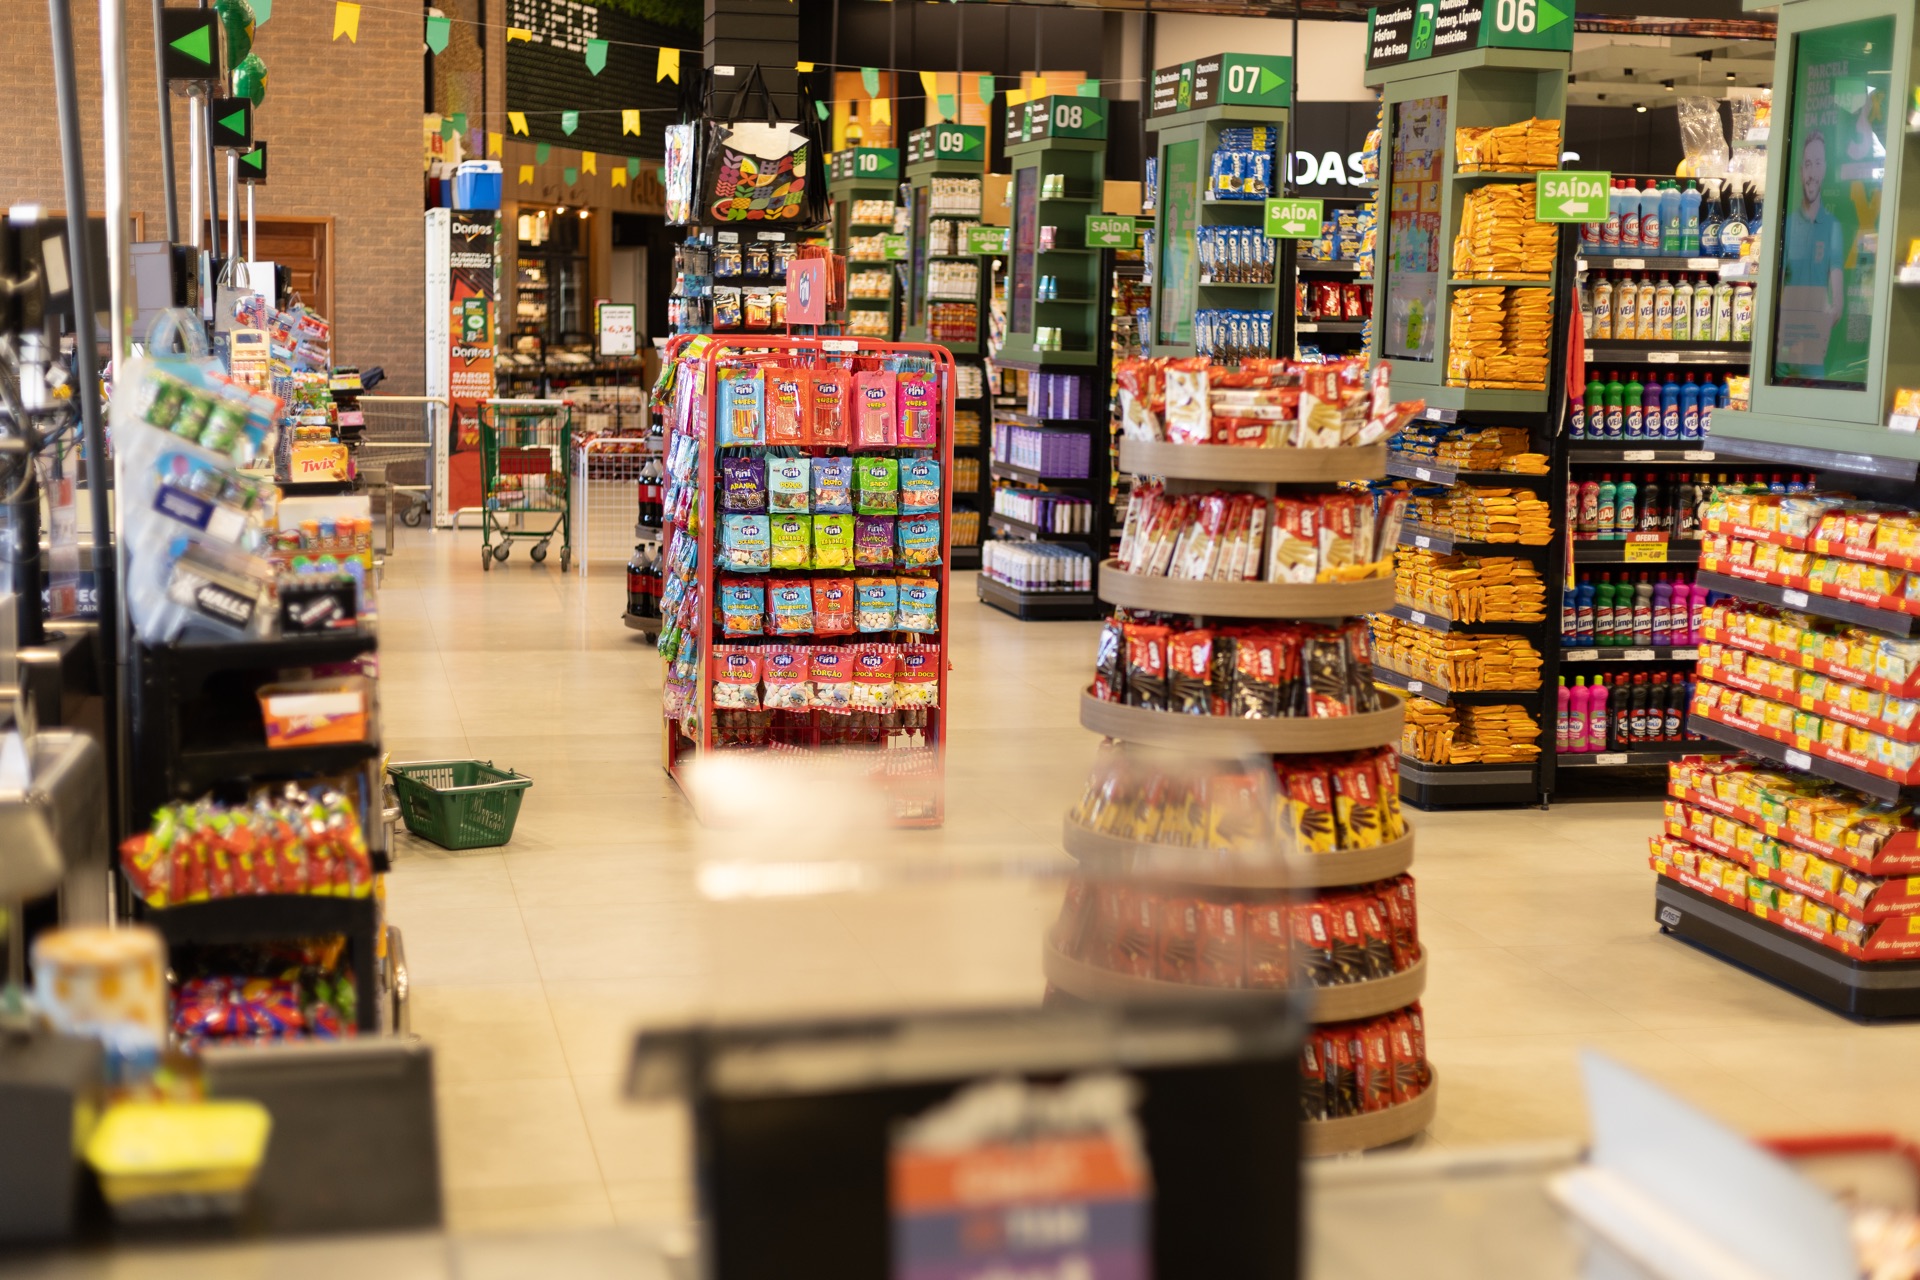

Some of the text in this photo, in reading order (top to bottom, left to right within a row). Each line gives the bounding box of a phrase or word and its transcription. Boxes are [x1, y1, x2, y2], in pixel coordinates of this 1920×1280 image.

[1376, 9, 1412, 26] Descartáveis
[1436, 9, 1482, 28] Deterg. Líquido
[1496, 0, 1536, 33] 06
[1374, 29, 1396, 42] Fósforo
[1435, 30, 1468, 46] Inseticidas
[1374, 43, 1408, 58] Art. de Festa
[1808, 61, 1848, 78] PARCELE
[1228, 65, 1260, 93] 07
[1808, 80, 1830, 94] SUAS
[1056, 104, 1082, 128] 08
[1806, 113, 1818, 127] EM
[940, 132, 964, 152] 09
[858, 154, 878, 172] 10
[1544, 177, 1604, 198] SAÍDA
[1272, 204, 1317, 220] SAÍDA
[452, 222, 492, 235] Doritos
[1092, 219, 1130, 232] SAÍDA
[452, 346, 490, 358] Doritos
[735, 386, 753, 394] Fini
[779, 383, 797, 393] Fini
[819, 385, 836, 393] Fini
[908, 386, 924, 395] Fini
[868, 390, 884, 398] Fini
[301, 458, 336, 472] Twix
[735, 469, 751, 478] Fini
[784, 469, 799, 477] Fini
[871, 468, 887, 476] Fini
[913, 467, 928, 475] Fini
[730, 482, 756, 490] ARANHA
[1621, 508, 1635, 519] UAU
[826, 526, 840, 534] Fini
[868, 524, 882, 533] Fini
[912, 525, 926, 533] Fini
[1636, 534, 1659, 542] OFERTA
[827, 590, 841, 599] Fini
[870, 589, 884, 597] Fini
[910, 590, 925, 598] Fini
[198, 586, 250, 618] HALLS
[729, 655, 746, 664] Fini
[775, 655, 792, 664] Fini
[818, 655, 837, 663] Fini
[863, 656, 881, 665] Fini
[906, 656, 923, 664] Fini
[811, 670, 842, 678] TORÇÃO
[1883, 855, 1920, 864] Meu tempe
[1874, 903, 1890, 912] Meu
[1662, 910, 1679, 922] FAST
[1875, 941, 1890, 949] Meu
